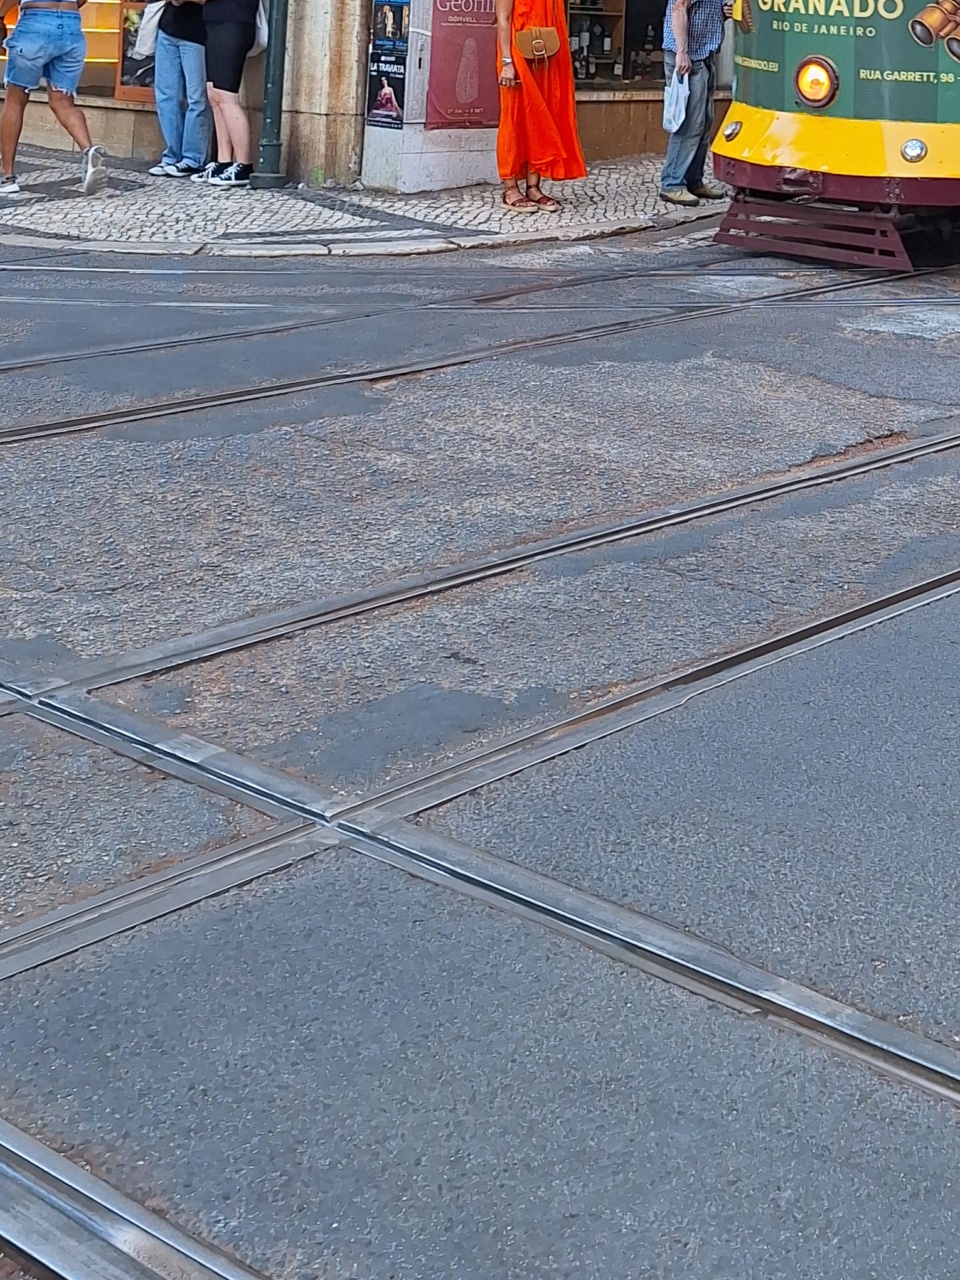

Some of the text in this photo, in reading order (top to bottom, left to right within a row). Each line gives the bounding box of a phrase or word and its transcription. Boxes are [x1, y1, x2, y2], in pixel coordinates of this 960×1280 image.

[772, 20, 876, 38] RIO DE JANEIRO
[370, 62, 378, 71] LA
[859, 69, 882, 80] RUA
[883, 70, 938, 84] GARRETT,
[939, 72, 955, 83] 98
